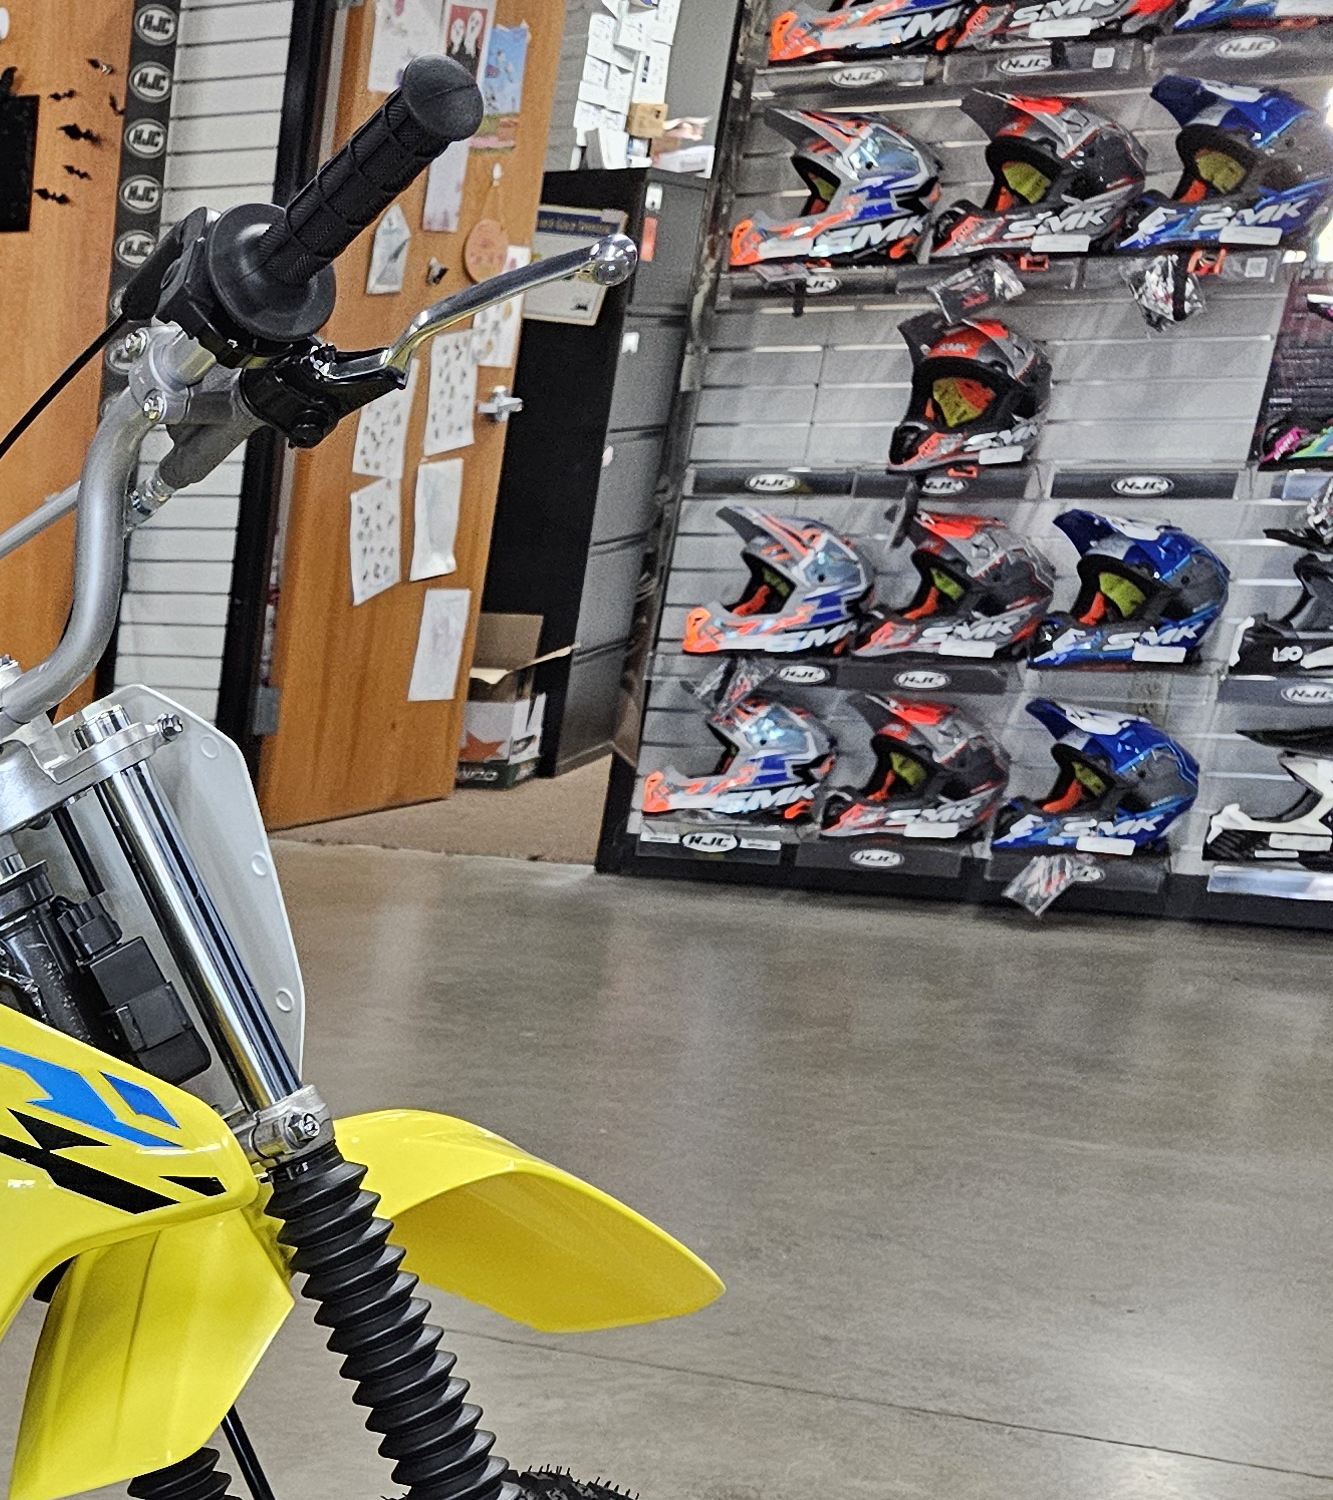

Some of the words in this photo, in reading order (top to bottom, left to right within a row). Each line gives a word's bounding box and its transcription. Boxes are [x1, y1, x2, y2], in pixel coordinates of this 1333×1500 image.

[143, 14, 171, 34] HJC
[137, 72, 166, 91] HJC
[133, 129, 161, 148] HJC
[127, 185, 156, 202] HJC
[1003, 205, 1112, 240] SMK
[1193, 199, 1310, 232] SMK
[918, 617, 1020, 644] SMK
[1103, 621, 1205, 651] SMK
[688, 836, 732, 848] HJC
